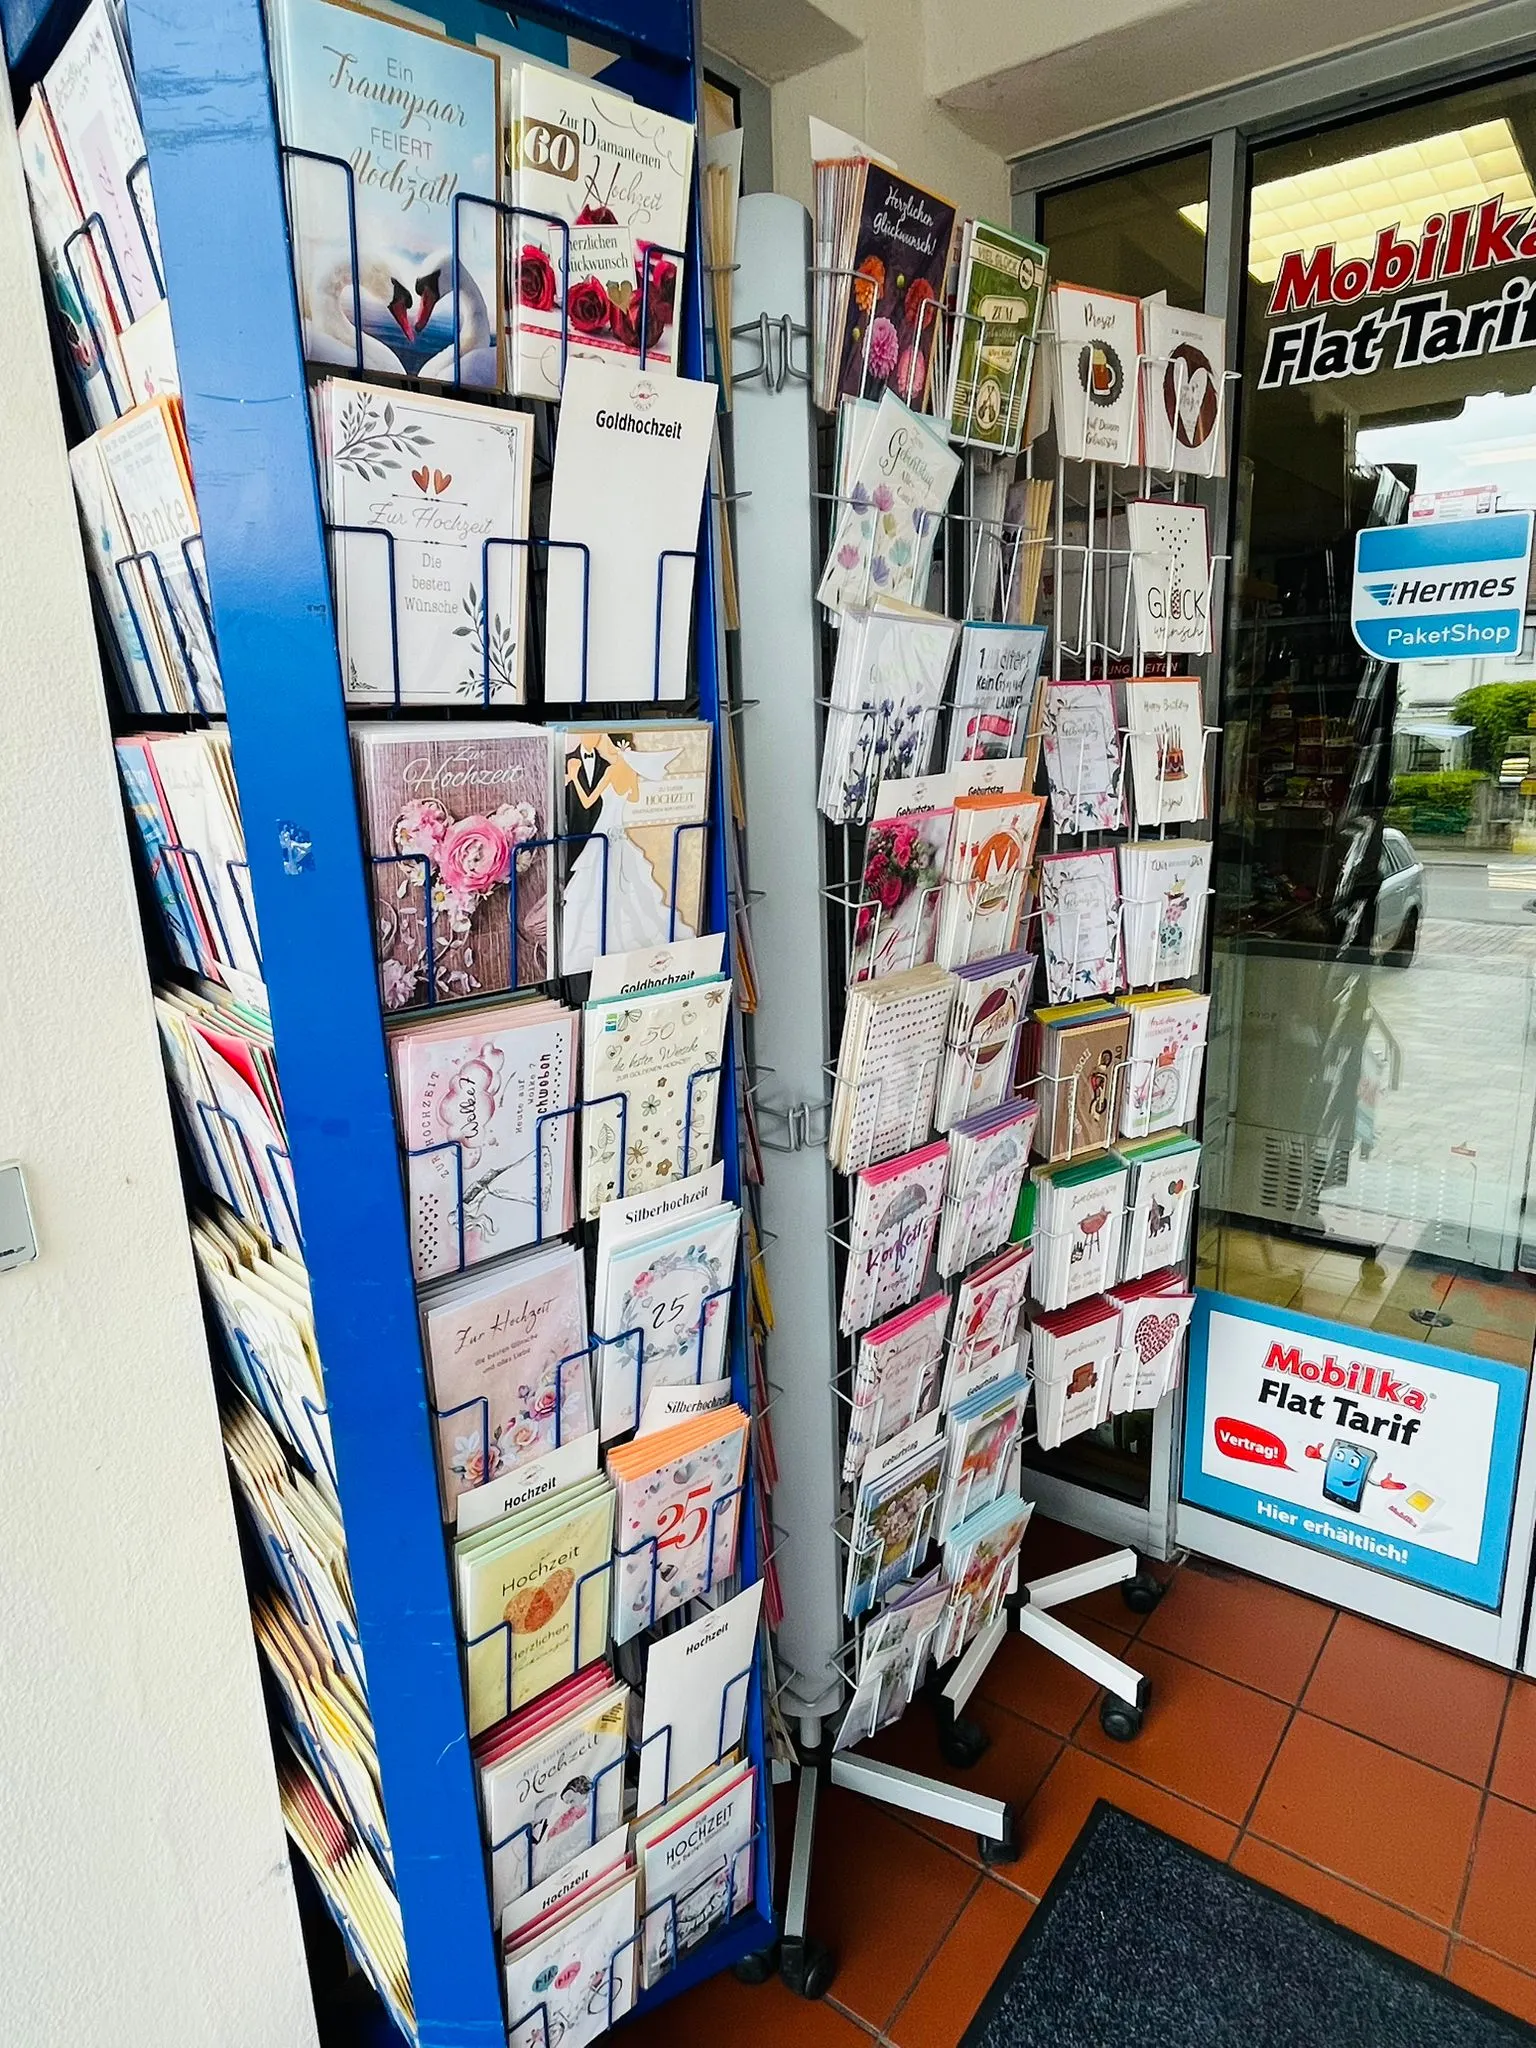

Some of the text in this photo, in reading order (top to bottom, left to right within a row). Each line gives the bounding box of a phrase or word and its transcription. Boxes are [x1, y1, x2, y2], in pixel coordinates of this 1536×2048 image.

[322, 44, 469, 131] Traumpaar
[386, 57, 414, 83] Ein
[558, 109, 580, 131] Zur
[370, 126, 433, 159] FEIERT
[523, 125, 577, 174] 60
[581, 117, 662, 170] Diamantenen
[583, 155, 664, 224] Hochzeit
[885, 185, 934, 227] Herzlichen
[872, 211, 937, 256] Glückwunsch!
[1257, 312, 1386, 390] Flat
[595, 409, 682, 440] Goldhochzeit
[367, 502, 493, 541] Zur Hochzeit
[421, 552, 442, 569] Die
[411, 574, 451, 592] besten
[1397, 576, 1517, 605] Hermes
[404, 596, 459, 616] Wünsche
[1387, 623, 1511, 647] PaketShop
[451, 744, 488, 763] Zur
[403, 756, 526, 793] Hochzeit
[422, 1071, 450, 1179] ZUR HOCHZEIT
[624, 1185, 709, 1226] Silberhochzeit
[454, 1296, 559, 1355] Zur Hochzeit
[652, 1293, 690, 1330] 25
[1262, 1340, 1429, 1414] Mobilka
[1258, 1377, 1422, 1446] Flat Tarif
[882, 1440, 918, 1469] Geburtstag
[1219, 1429, 1280, 1461] Vertrag!
[504, 1476, 556, 1512] Hochzeit
[651, 1486, 711, 1551] 25
[1257, 1499, 1409, 1565] Hier erhältlich!
[502, 1545, 580, 1597] Hochzeit
[686, 1622, 729, 1656] Hochzeit
[516, 1732, 600, 1803] Hochzeit
[666, 1801, 734, 1866] HOCHZEIT
[542, 1869, 590, 1911] Hochzeit
